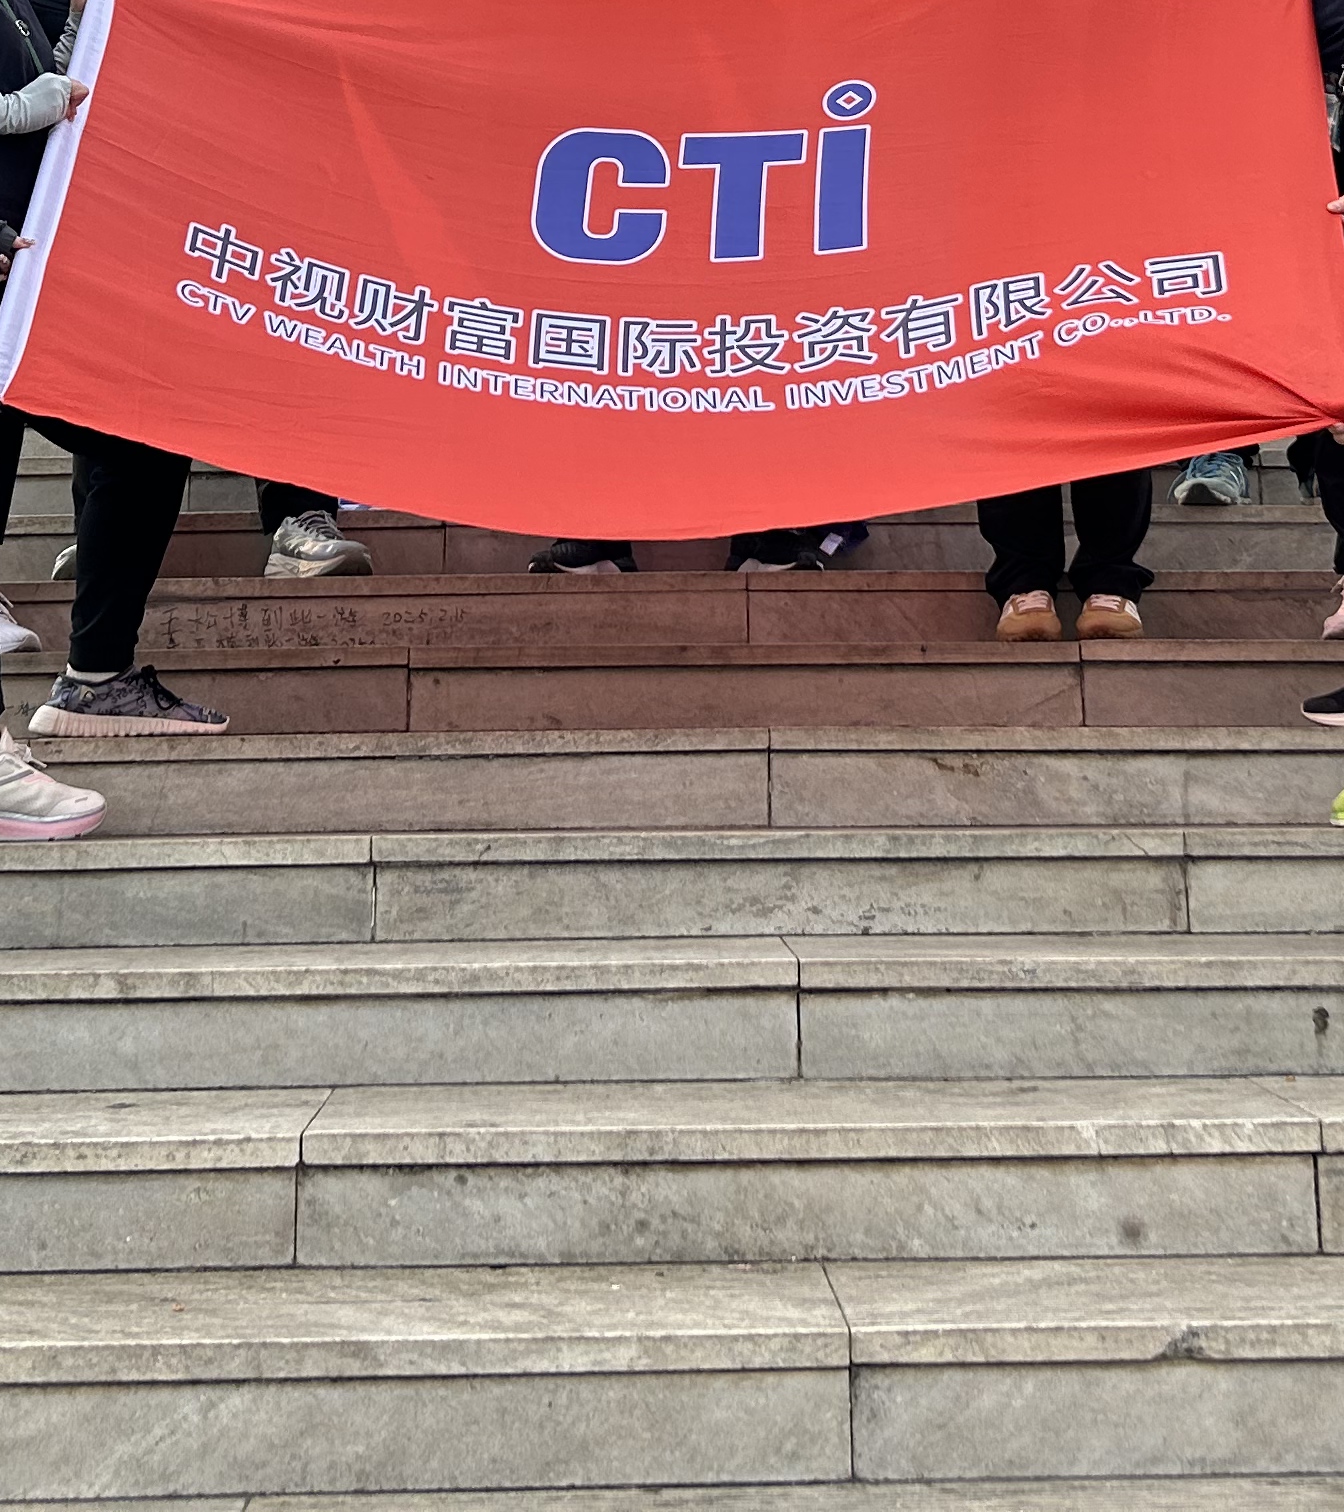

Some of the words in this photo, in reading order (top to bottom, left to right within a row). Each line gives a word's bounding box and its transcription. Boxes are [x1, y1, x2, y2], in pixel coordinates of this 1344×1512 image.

[176, 280, 257, 325] CTV
[264, 310, 426, 380] WEALTH
[438, 362, 775, 413] INTERNATIONAL
[786, 330, 1044, 409] INVESTMENT
[185, 221, 1228, 378] 中视财富国际投资有限公司
